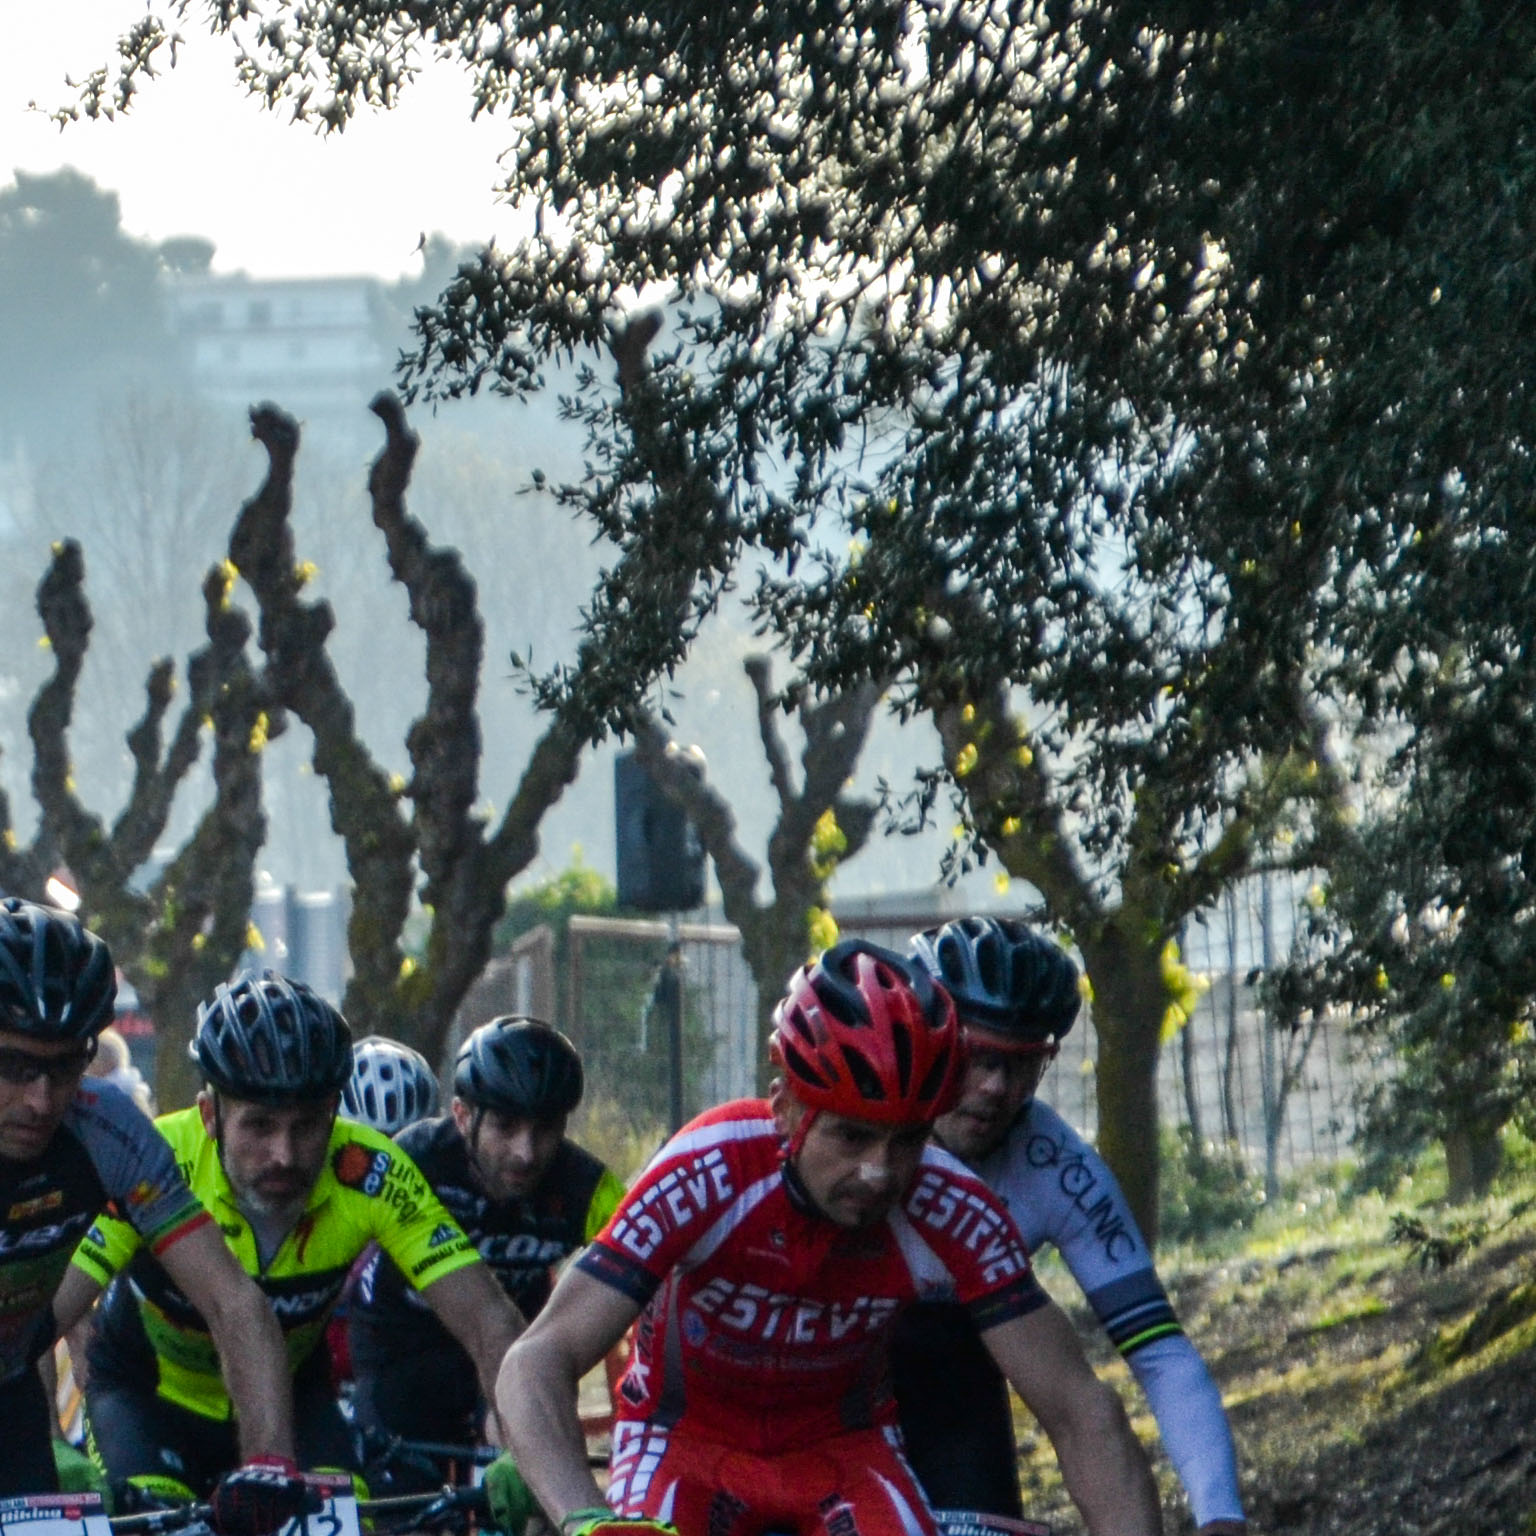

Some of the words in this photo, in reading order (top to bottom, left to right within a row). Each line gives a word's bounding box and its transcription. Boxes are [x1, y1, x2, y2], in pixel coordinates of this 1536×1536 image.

[610, 1147, 736, 1262] ESTEVE
[906, 1174, 1030, 1284] ESTEVE
[691, 1276, 901, 1344] ESTEVE
